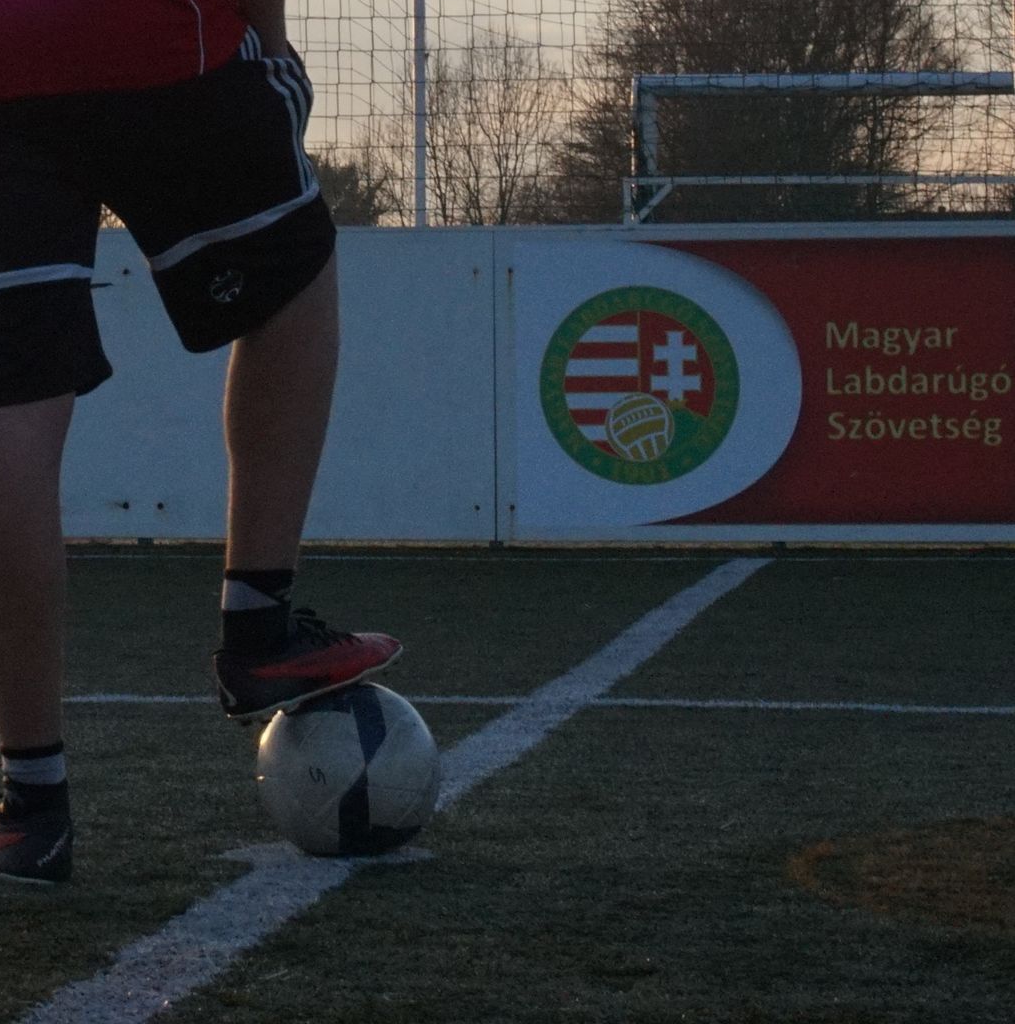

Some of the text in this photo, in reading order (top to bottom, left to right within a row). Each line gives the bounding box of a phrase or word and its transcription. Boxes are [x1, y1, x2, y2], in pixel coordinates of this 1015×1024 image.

[825, 321, 959, 356] Magyar
[826, 362, 1012, 401] Labdarúgó
[827, 408, 1003, 446] Szövetség
